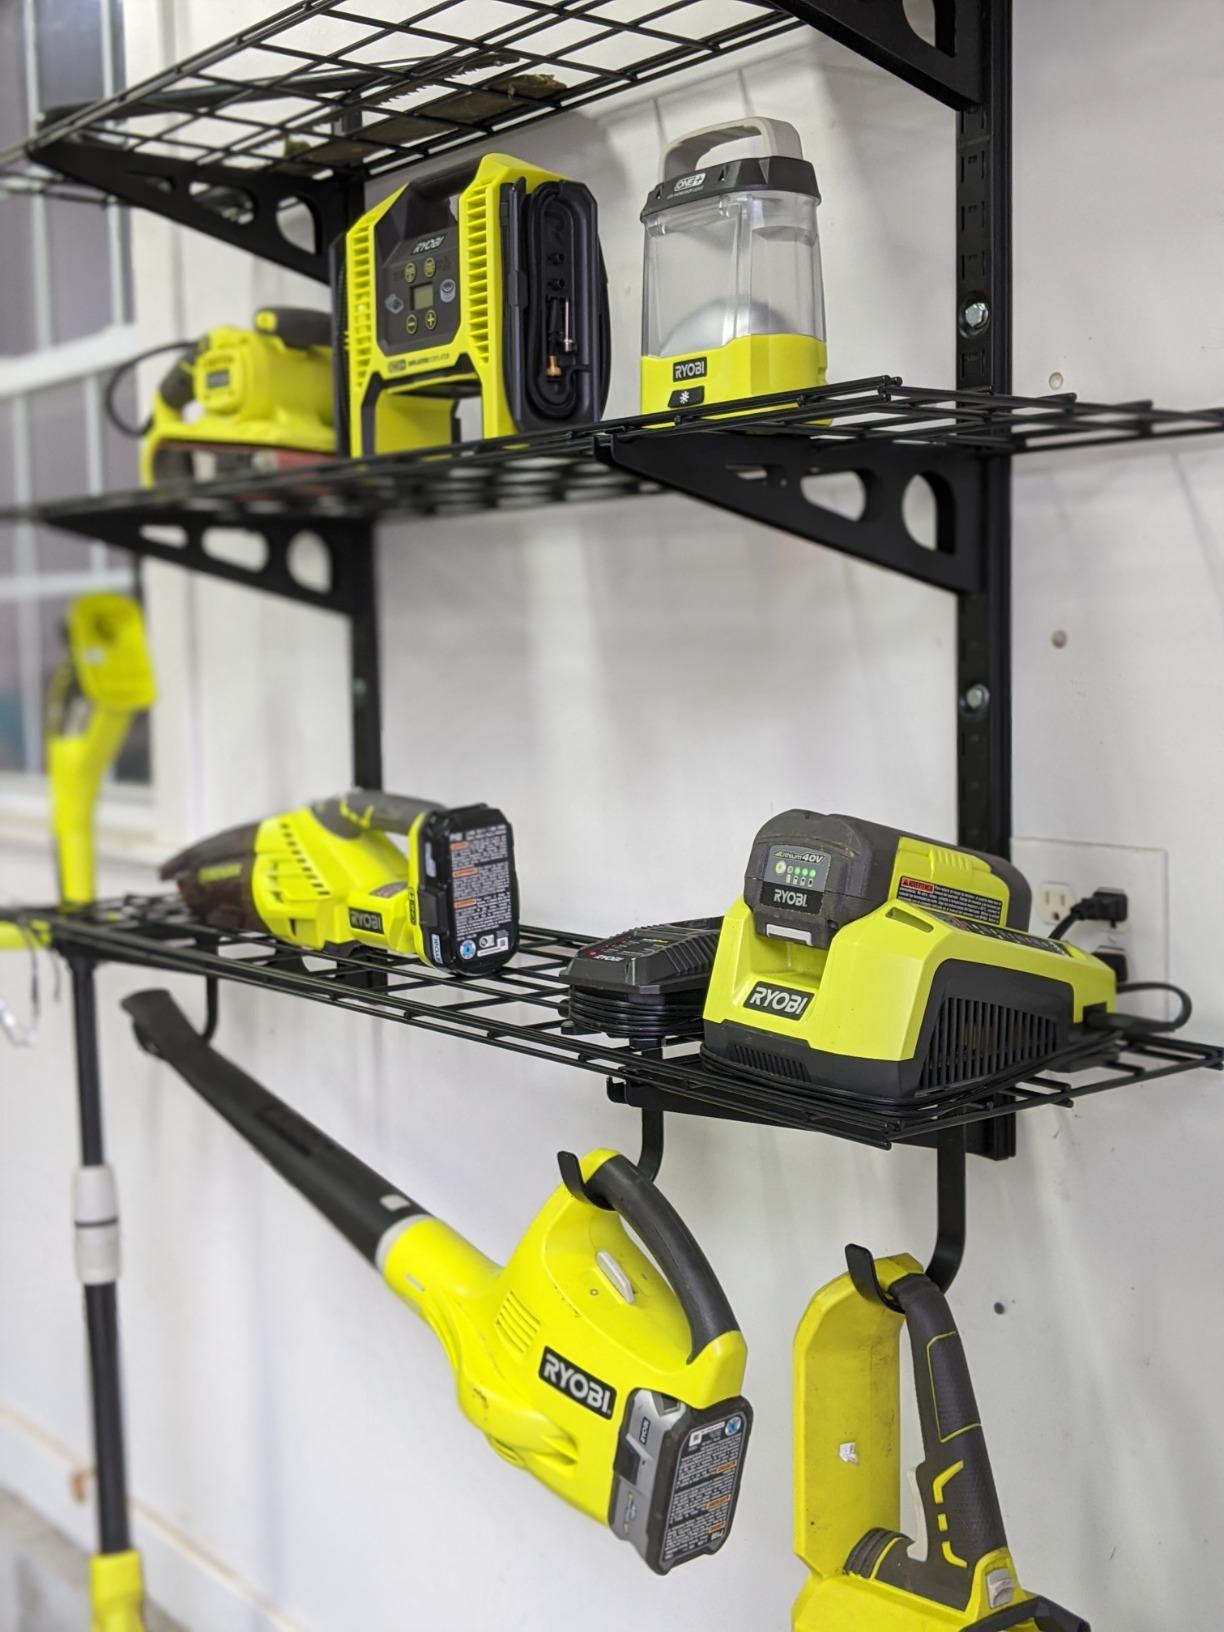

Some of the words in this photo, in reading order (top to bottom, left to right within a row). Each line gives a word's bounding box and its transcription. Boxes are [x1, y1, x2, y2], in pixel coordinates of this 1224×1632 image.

[412, 236, 445, 254] RYOBI
[675, 360, 705, 379] RYOBI
[801, 853, 824, 863] 40V
[773, 888, 808, 908] RYOBI
[351, 909, 382, 931] RYOBI
[750, 986, 808, 1015] RYOBI
[543, 1353, 612, 1415] RYOBI
